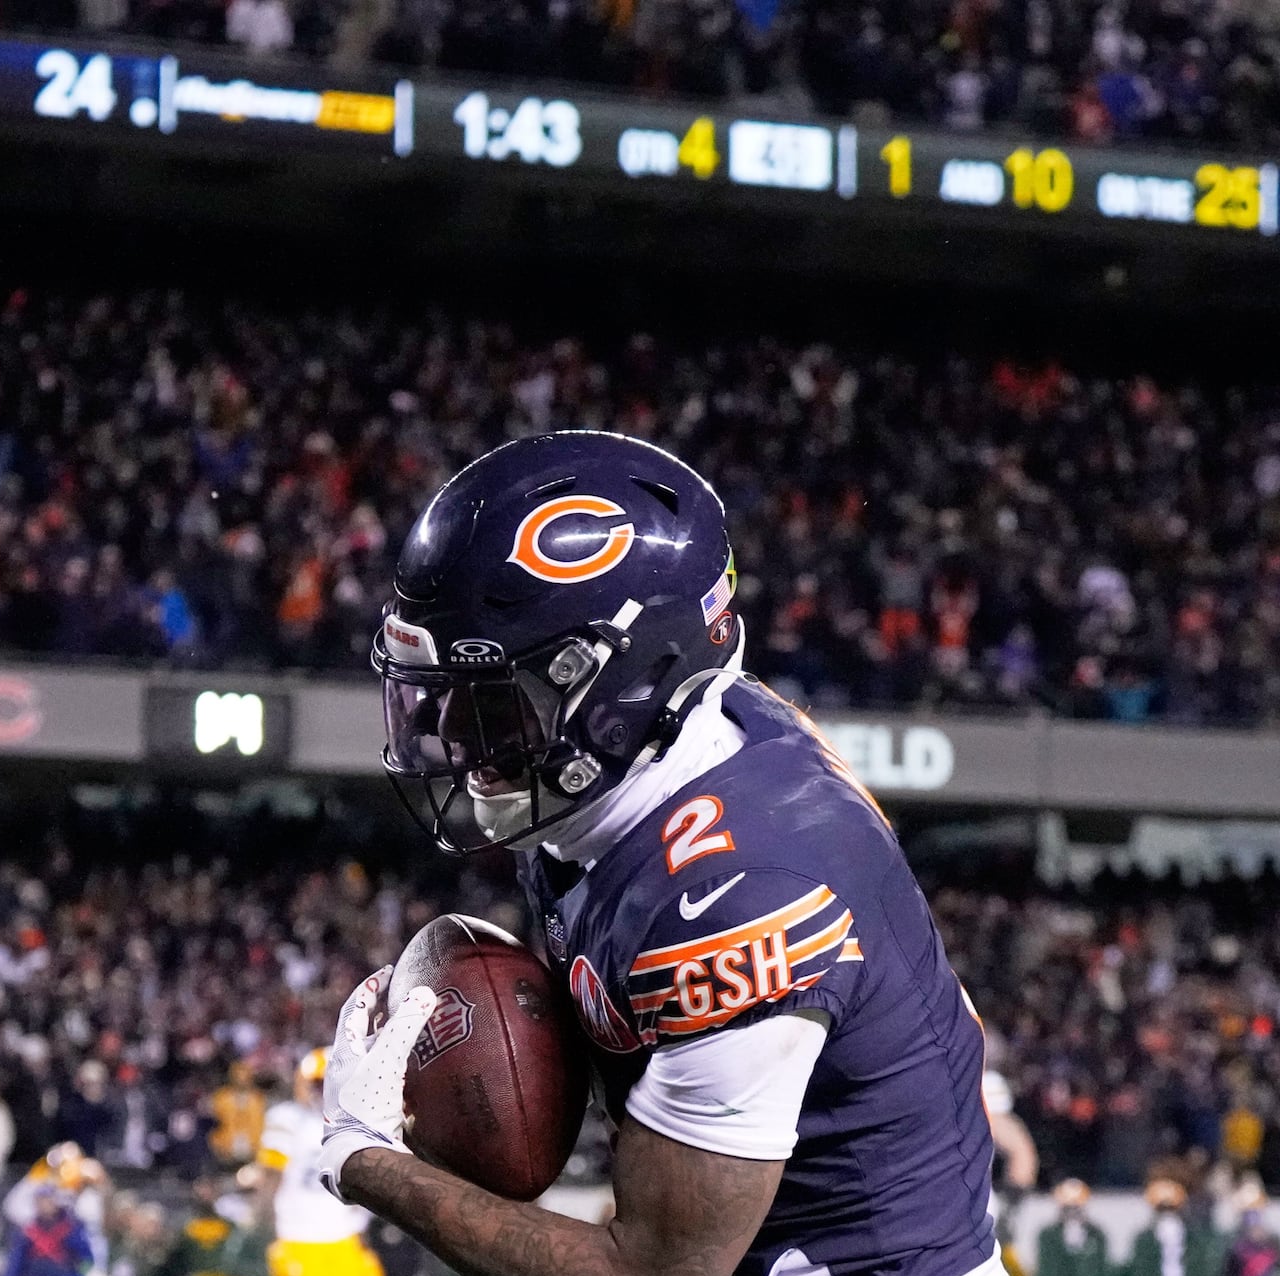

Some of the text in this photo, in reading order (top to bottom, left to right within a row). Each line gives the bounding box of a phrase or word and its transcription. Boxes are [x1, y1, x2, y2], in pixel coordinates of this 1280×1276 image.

[34, 50, 117, 122] 24
[453, 92, 582, 167] 1:43
[677, 115, 719, 180] 4
[880, 136, 912, 198] 1
[1004, 147, 1074, 213] 10
[1194, 163, 1261, 229] 25
[386, 623, 420, 648] BARS
[450, 655, 500, 663] OAKLEY
[821, 722, 955, 791] ELD
[661, 794, 736, 876] 2
[674, 928, 793, 1018] GSH
[429, 993, 464, 1046] NFL
